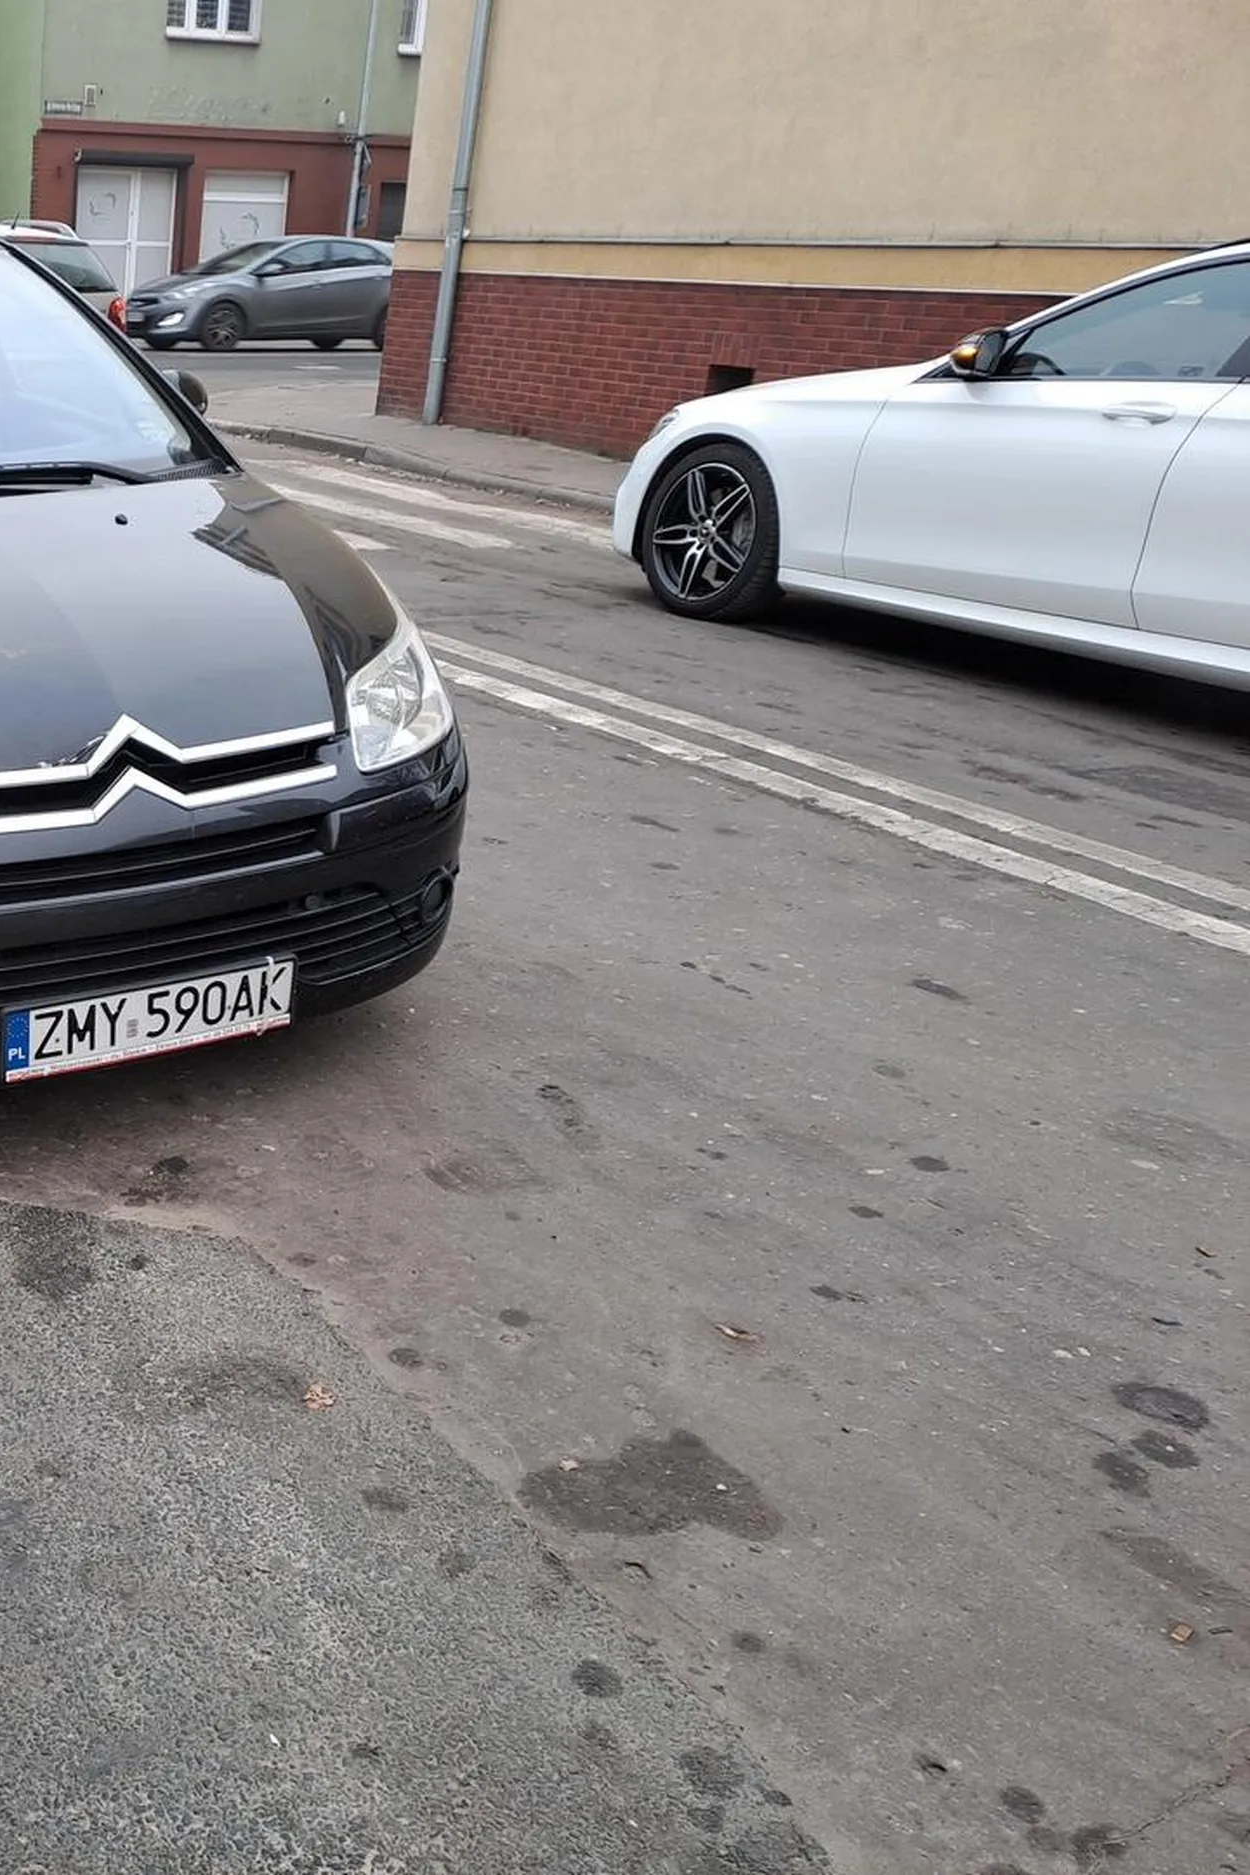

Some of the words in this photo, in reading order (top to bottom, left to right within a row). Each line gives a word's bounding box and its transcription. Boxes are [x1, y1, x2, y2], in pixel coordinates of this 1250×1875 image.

[34, 998, 127, 1060] ZMY
[146, 966, 286, 1038] 590AK
[7, 1046, 27, 1061] PL
